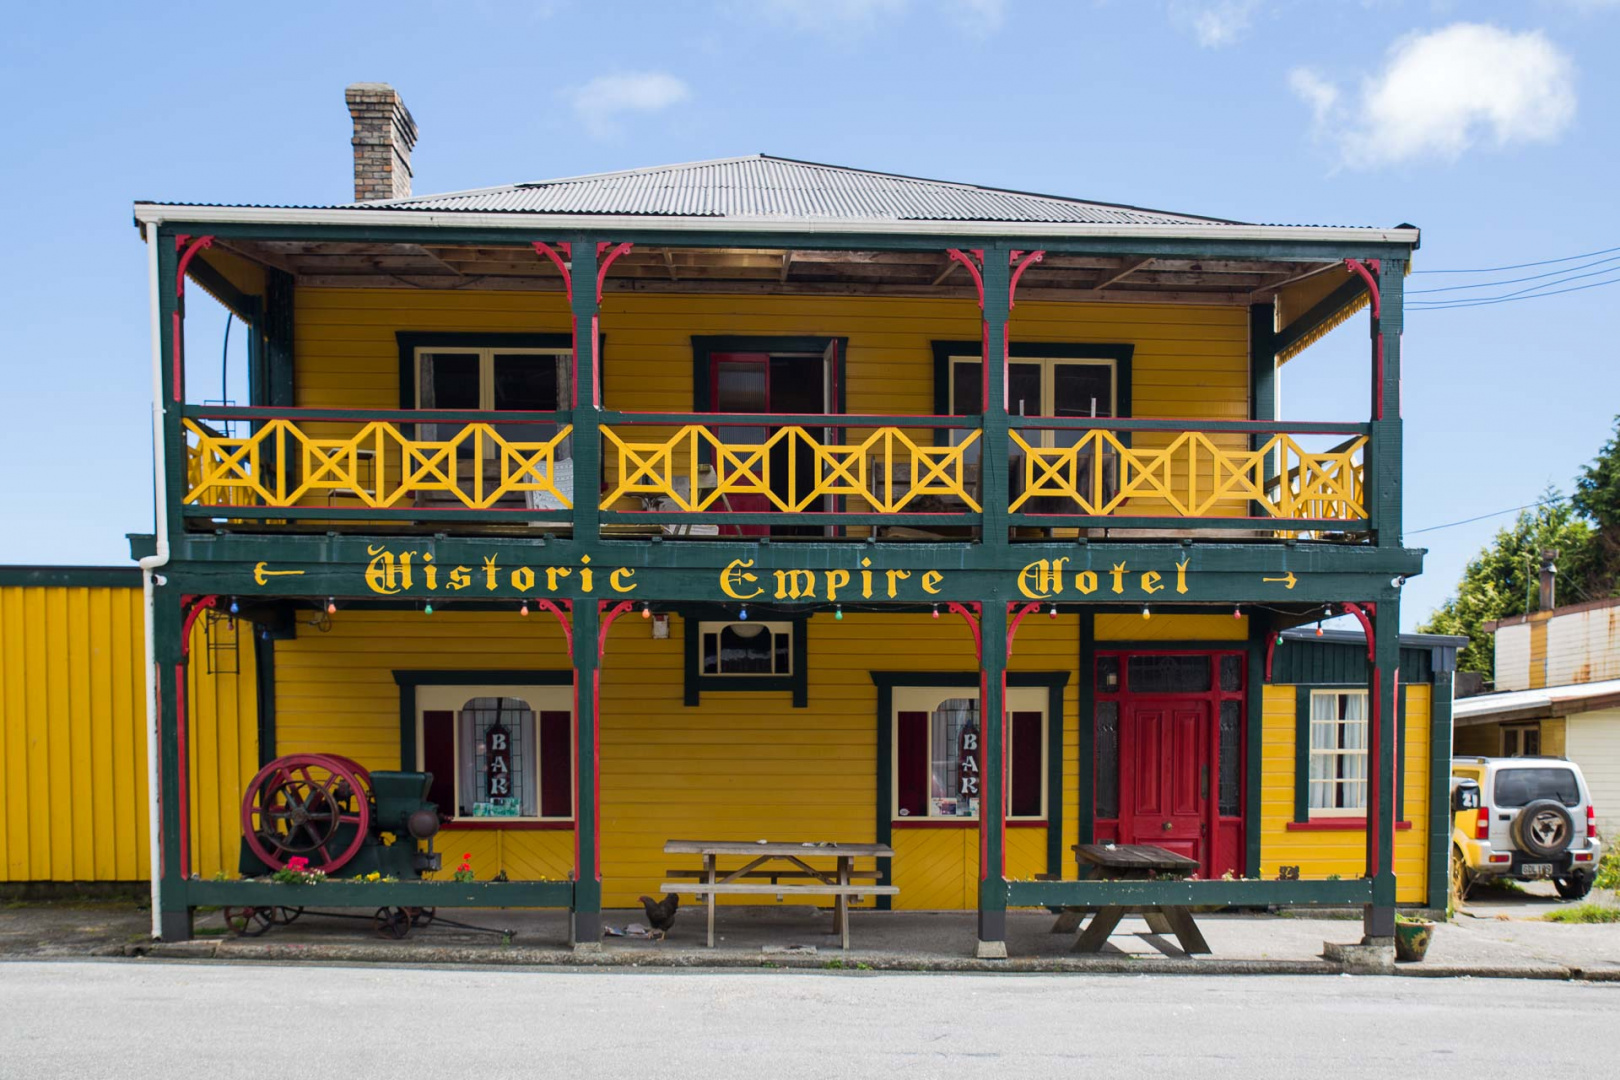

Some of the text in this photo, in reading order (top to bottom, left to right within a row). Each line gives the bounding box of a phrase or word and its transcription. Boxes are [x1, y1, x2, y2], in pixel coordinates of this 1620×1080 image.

[364, 544, 1191, 601] Historic Empire Hotel
[491, 733, 509, 795] BAR
[961, 733, 979, 794] BAR
[1462, 793, 1478, 808] 21
